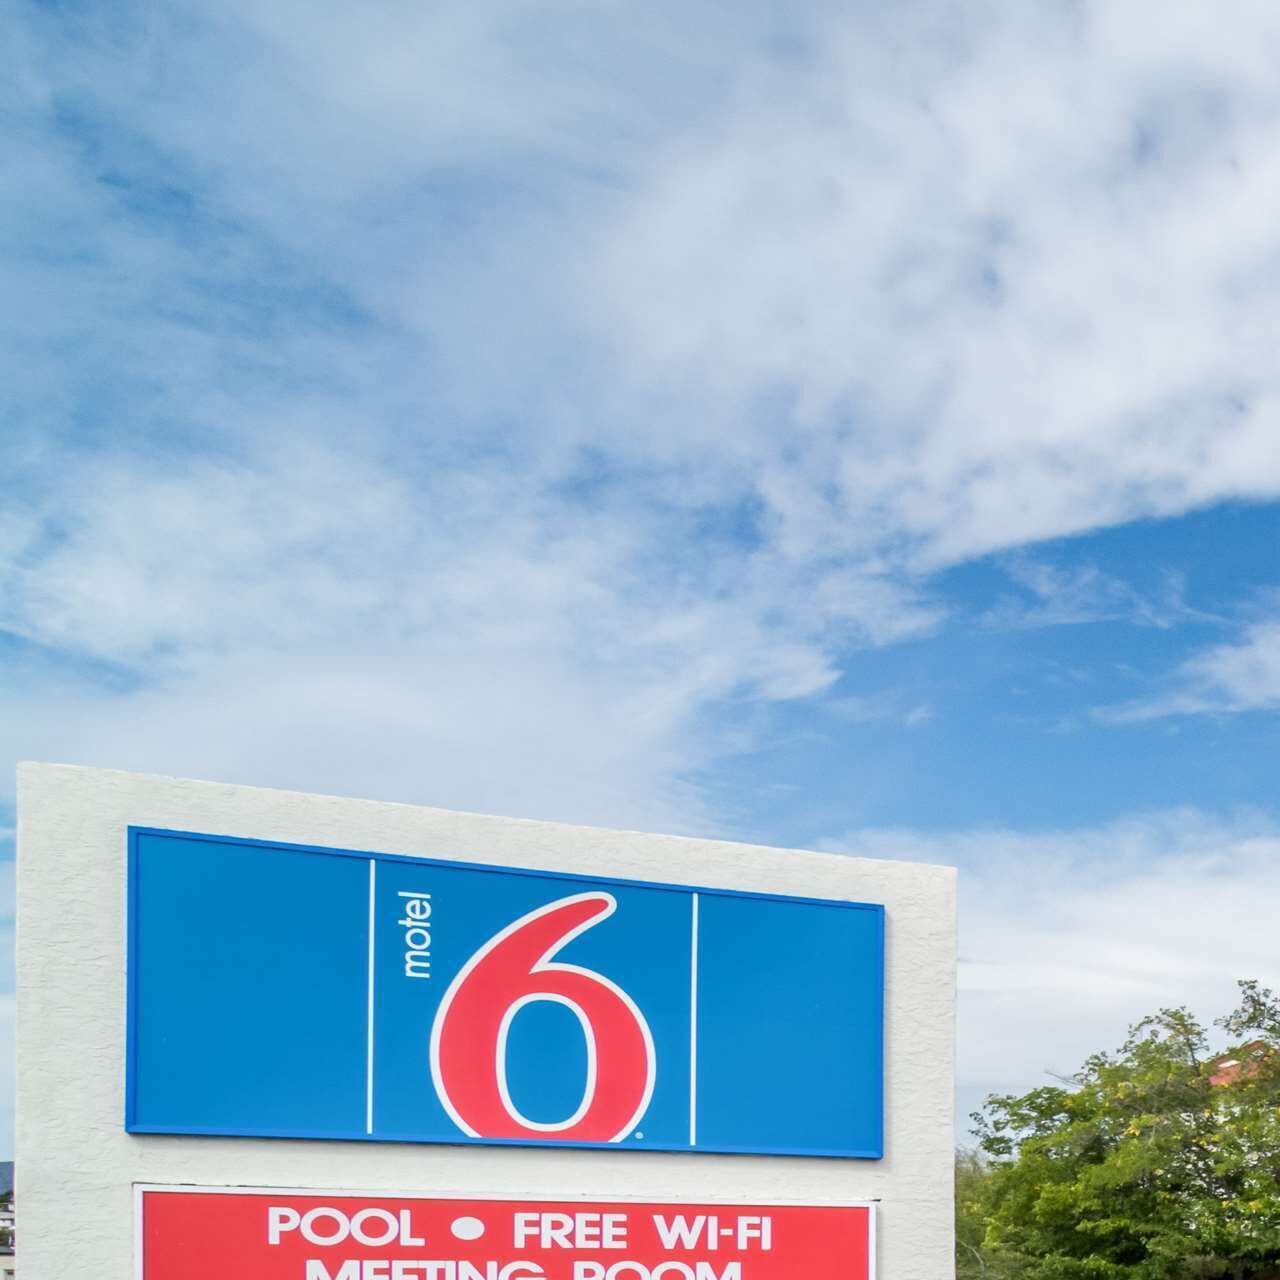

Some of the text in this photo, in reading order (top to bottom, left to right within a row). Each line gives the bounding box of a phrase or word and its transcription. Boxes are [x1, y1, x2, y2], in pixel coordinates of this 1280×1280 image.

[397, 890, 657, 1143] motel 6
[268, 1206, 773, 1251] POOL FREE WI-FI
